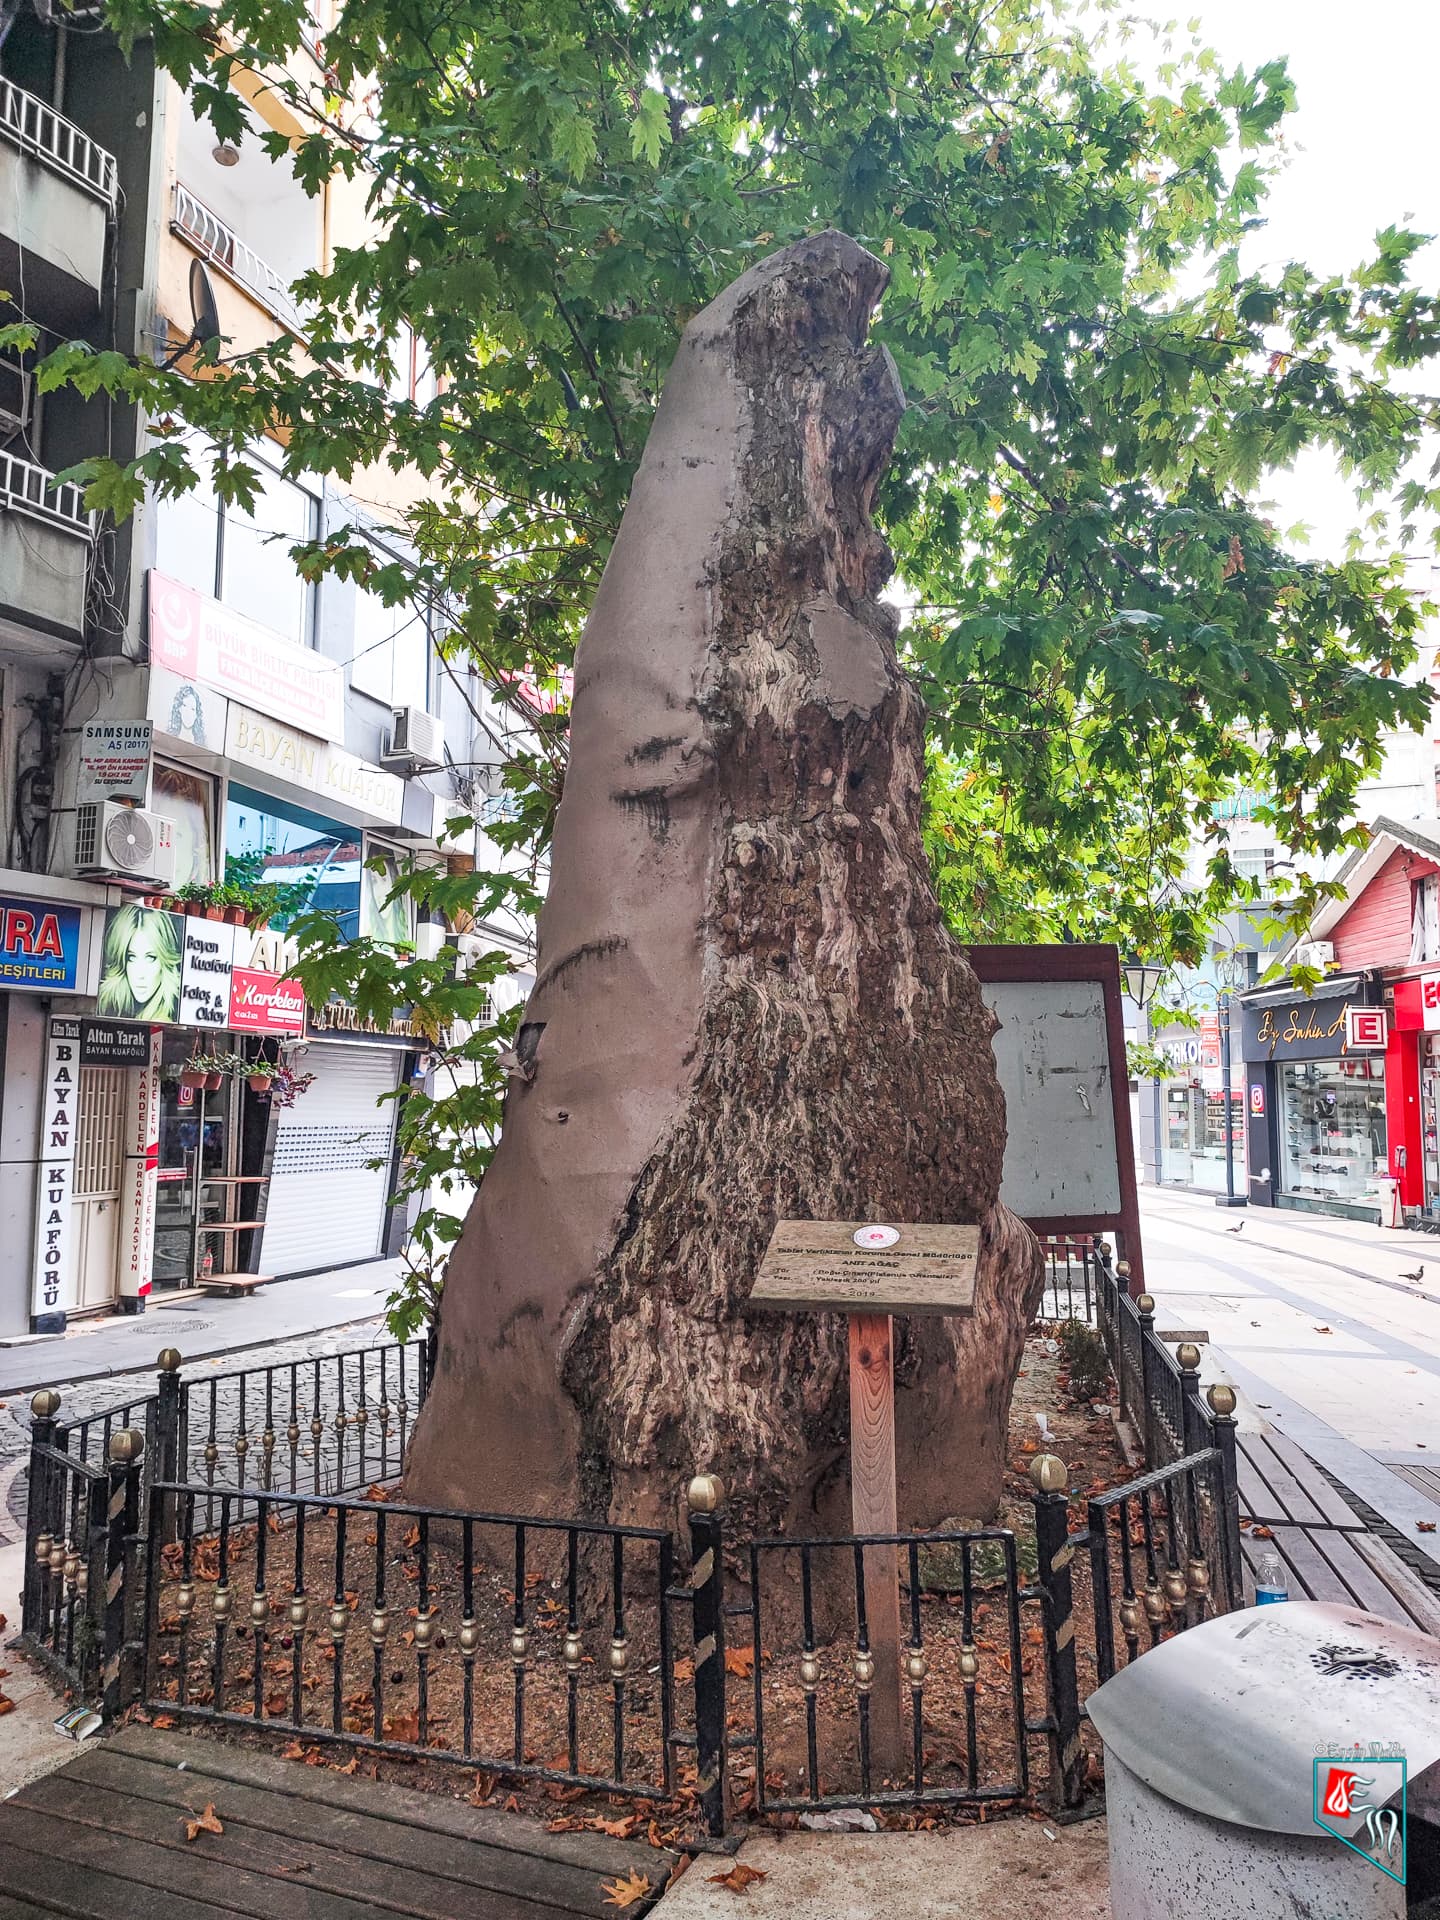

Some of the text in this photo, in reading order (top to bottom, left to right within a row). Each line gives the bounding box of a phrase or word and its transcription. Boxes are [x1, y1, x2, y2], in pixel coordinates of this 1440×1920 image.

[205, 624, 247, 657] BÜYÜK
[87, 727, 150, 738] SAMSUNG
[108, 741, 149, 750] A5 (2017)
[235, 719, 315, 777] BAYAN
[187, 935, 219, 953] Bayan
[214, 995, 223, 1008] &
[242, 984, 302, 1010] Kardelen
[1424, 981, 1440, 1009] E
[196, 1006, 226, 1024] Oktay
[87, 1028, 145, 1046] Altın Tarak
[1257, 1010, 1281, 1060] By
[1358, 1017, 1378, 1041] E
[86, 1047, 145, 1057] BAYAN KUAFÖRÜ
[50, 1045, 73, 1147] BAYAN
[151, 1041, 159, 1135] KARDELEN
[137, 1070, 147, 1153] KARDELEN
[43, 1168, 65, 1306] KUAFÖRÜ
[868, 1260, 900, 1268] AĞAÇ
